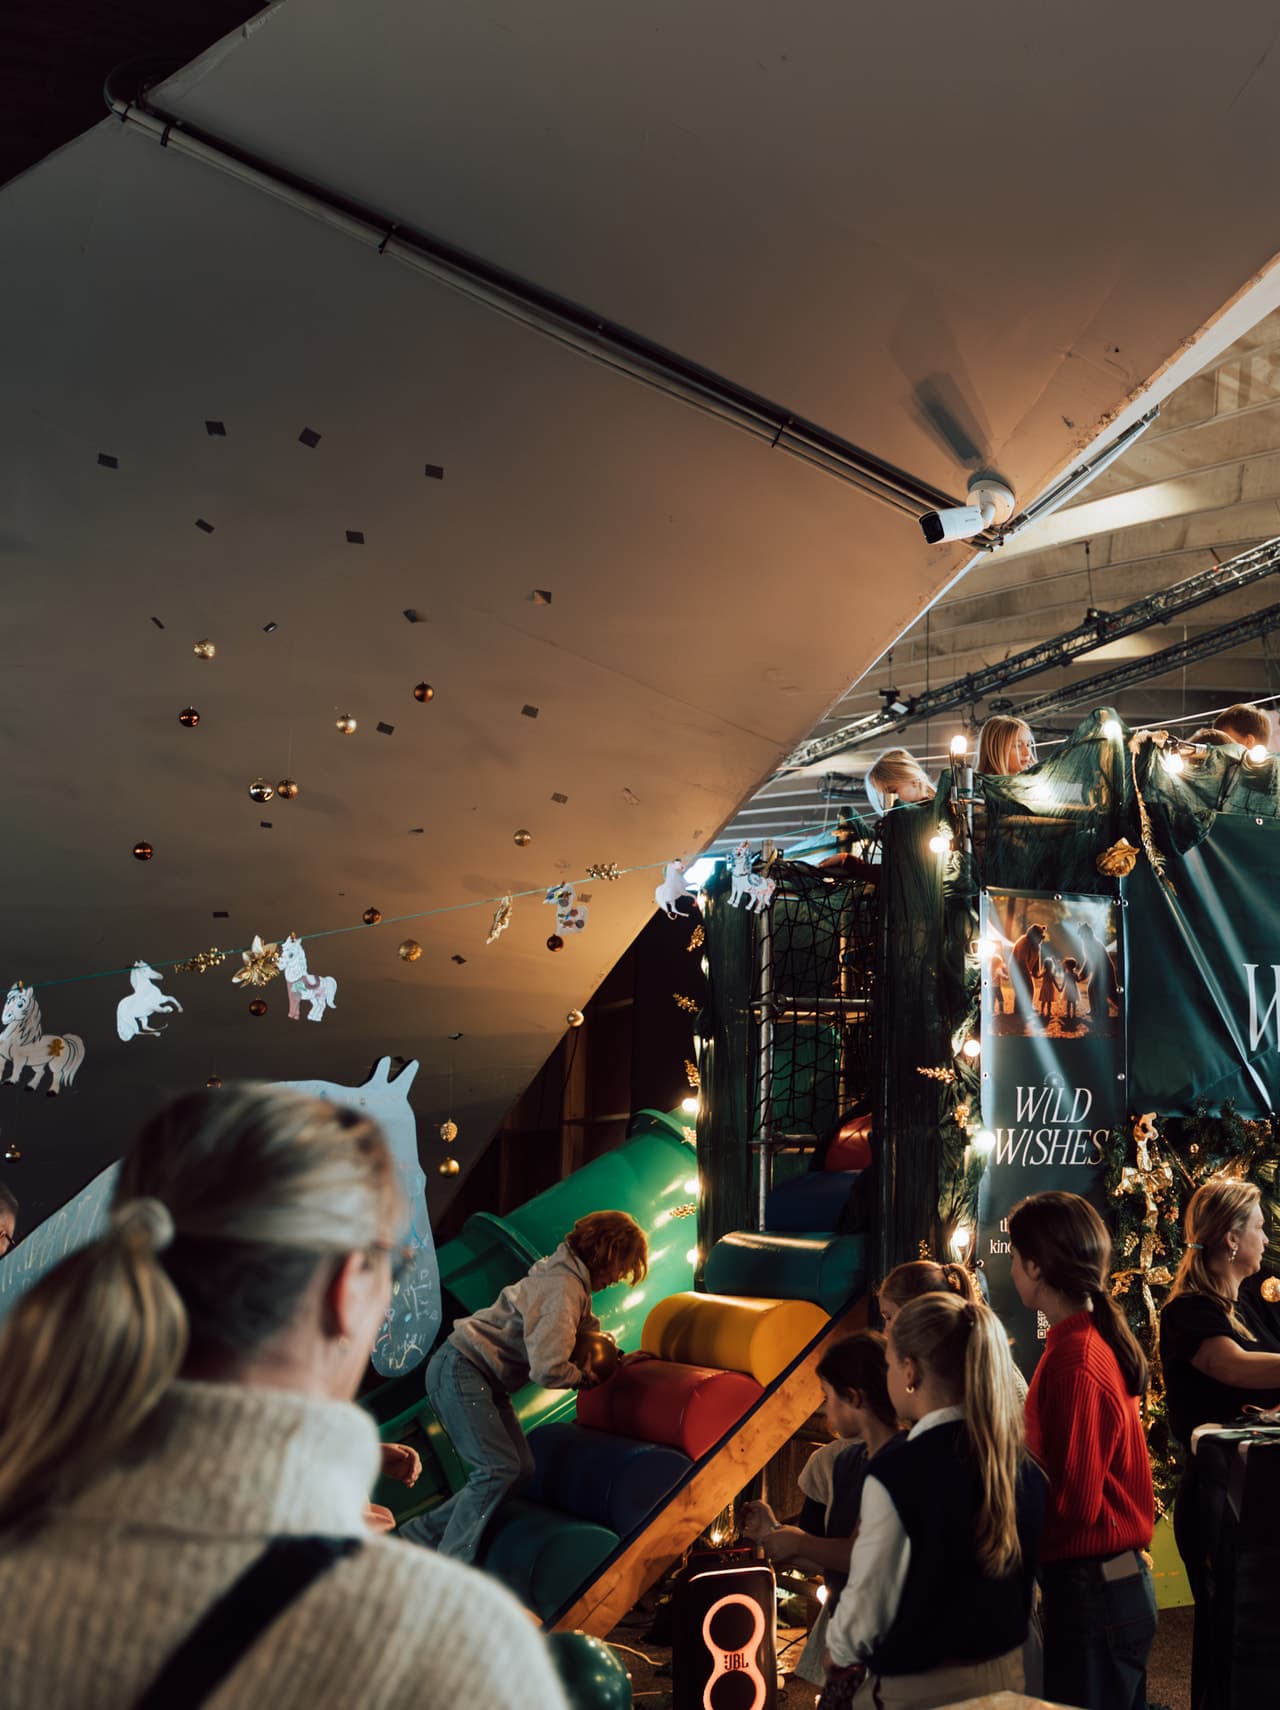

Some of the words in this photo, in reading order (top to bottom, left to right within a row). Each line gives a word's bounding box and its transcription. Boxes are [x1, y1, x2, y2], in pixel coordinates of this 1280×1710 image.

[1015, 1086, 1093, 1125] WILD
[995, 1128, 1110, 1167] WISHES
[724, 1653, 749, 1671] JBL
